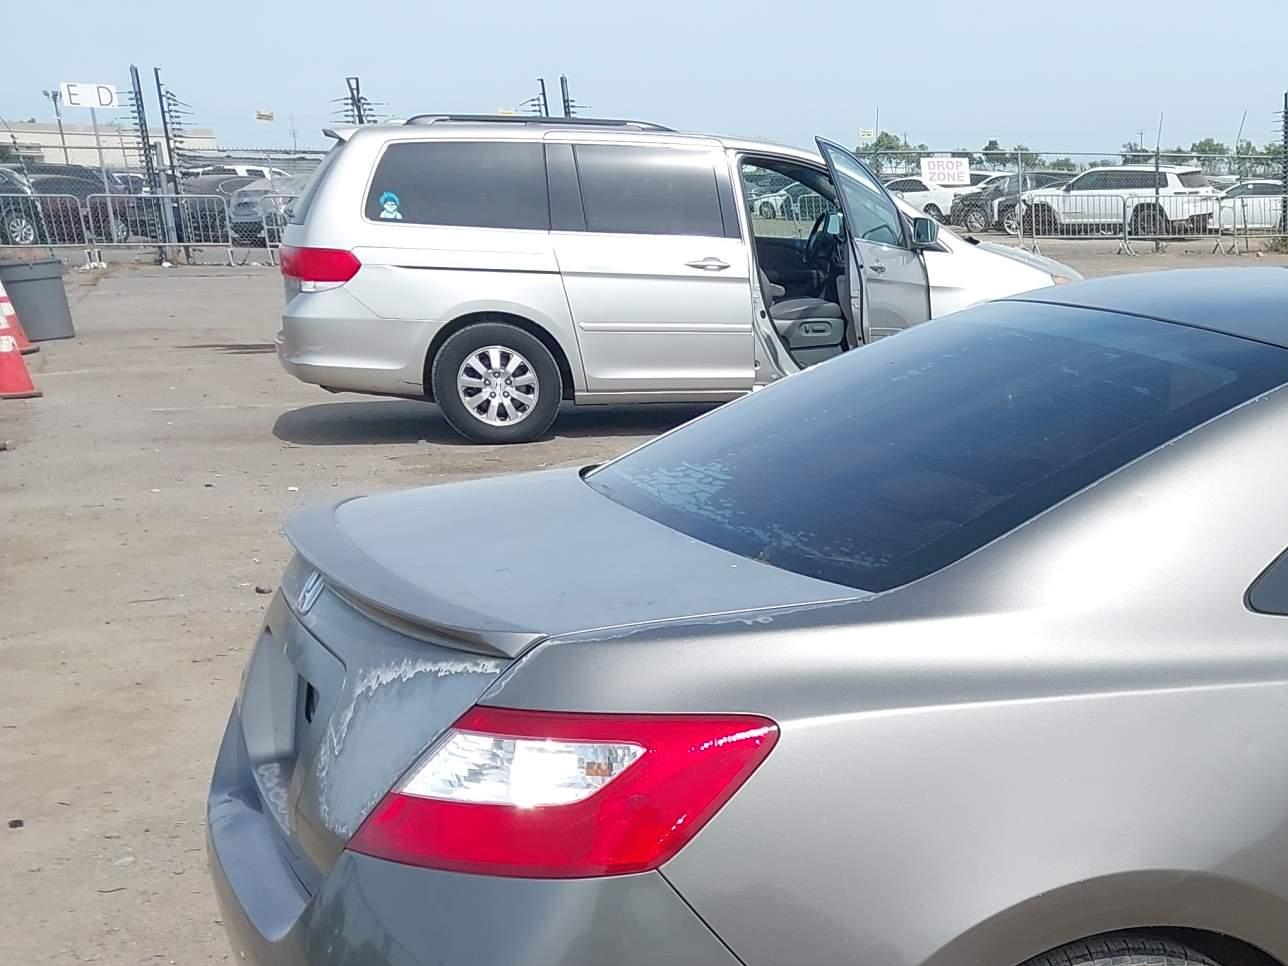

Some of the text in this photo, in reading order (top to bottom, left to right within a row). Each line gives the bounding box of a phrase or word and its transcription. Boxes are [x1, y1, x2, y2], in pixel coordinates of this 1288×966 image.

[67, 84, 113, 106] E D
[927, 160, 964, 171] DROP
[928, 171, 965, 182] ZONE
